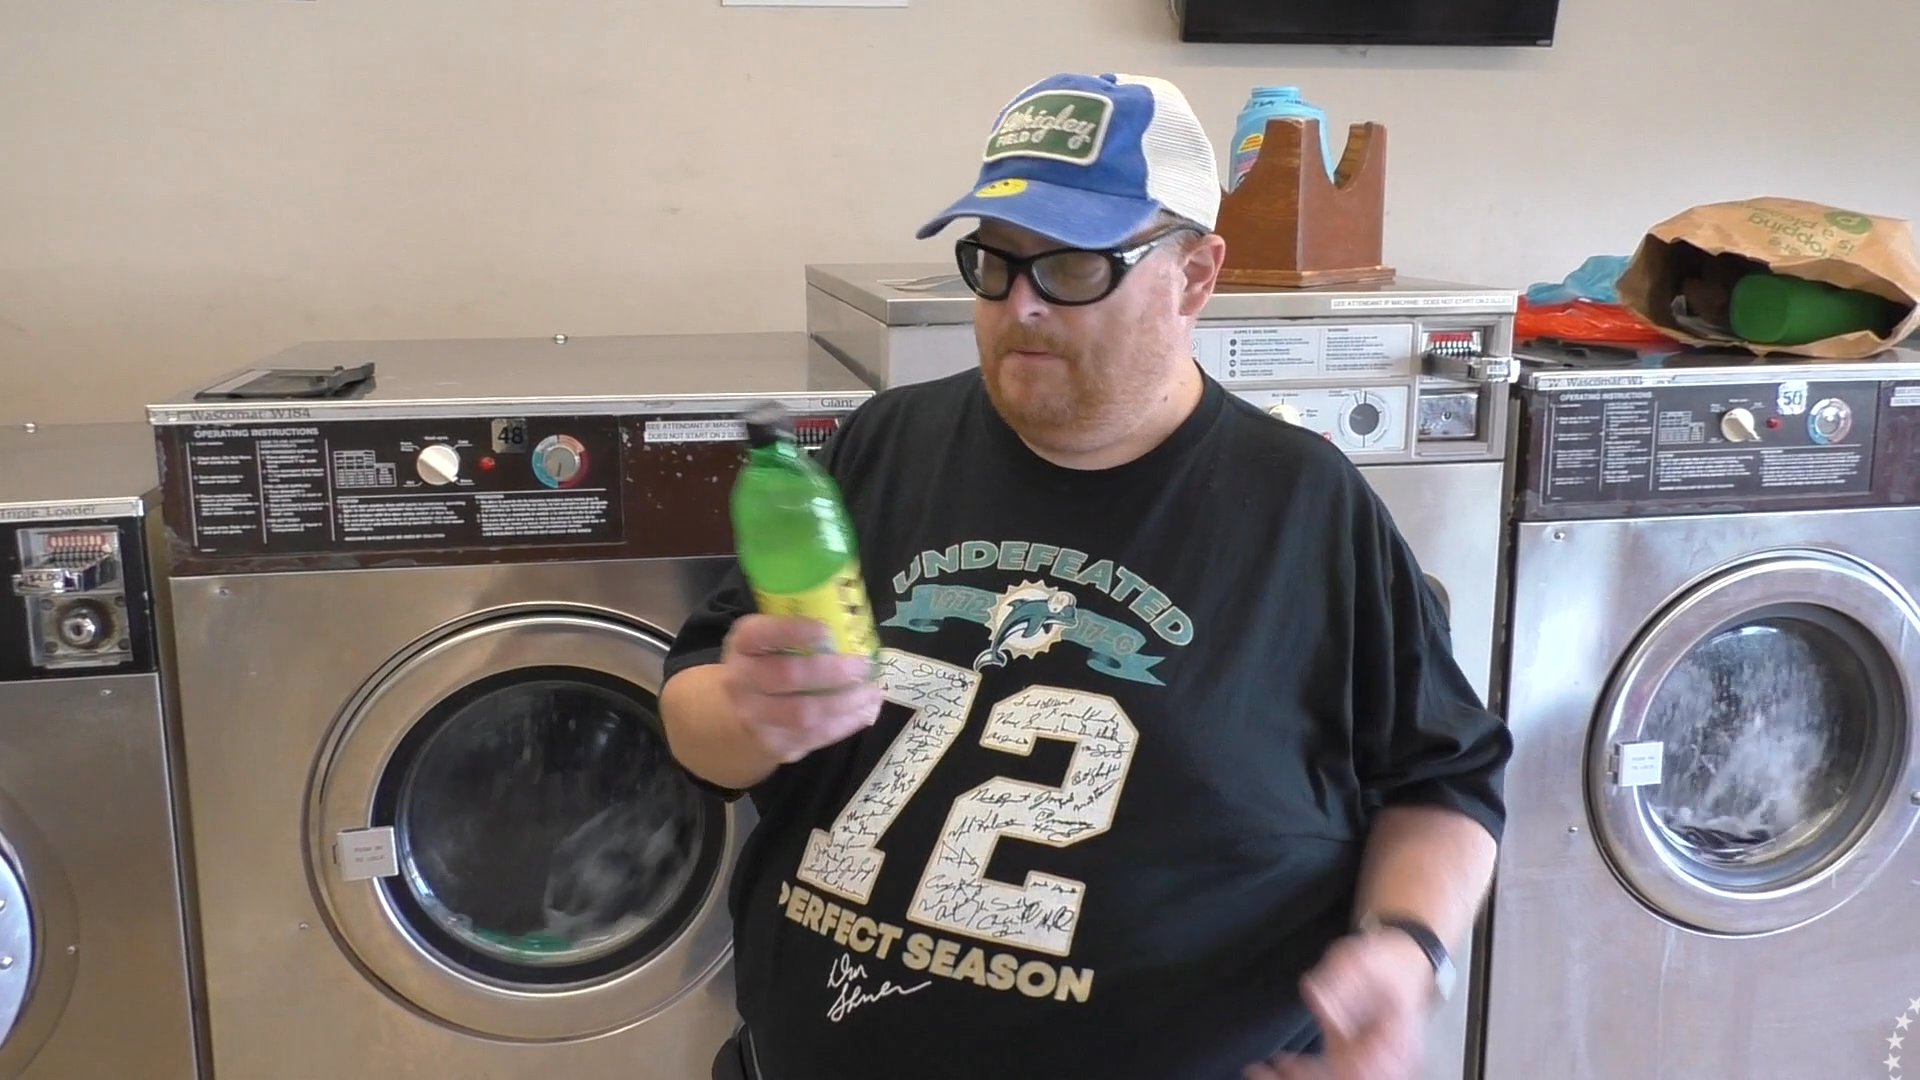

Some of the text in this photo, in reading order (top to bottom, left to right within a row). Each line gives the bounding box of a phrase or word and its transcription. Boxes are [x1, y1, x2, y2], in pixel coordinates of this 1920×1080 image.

[1559, 391, 1653, 401] OPERATING INSTRUCTIONS
[1783, 390, 1803, 406] 50
[820, 398, 855, 408] Giant
[191, 409, 266, 421] Wascomat
[662, 422, 703, 430] ATTENDANT
[194, 428, 319, 439] OPERATING INSTRUCTIONS
[497, 426, 524, 445] 48
[685, 431, 708, 439] START
[46, 504, 96, 516] Loader
[892, 541, 1194, 646] UNDEFEATED
[796, 648, 1139, 957] 72
[901, 932, 1095, 1004] SEASON
